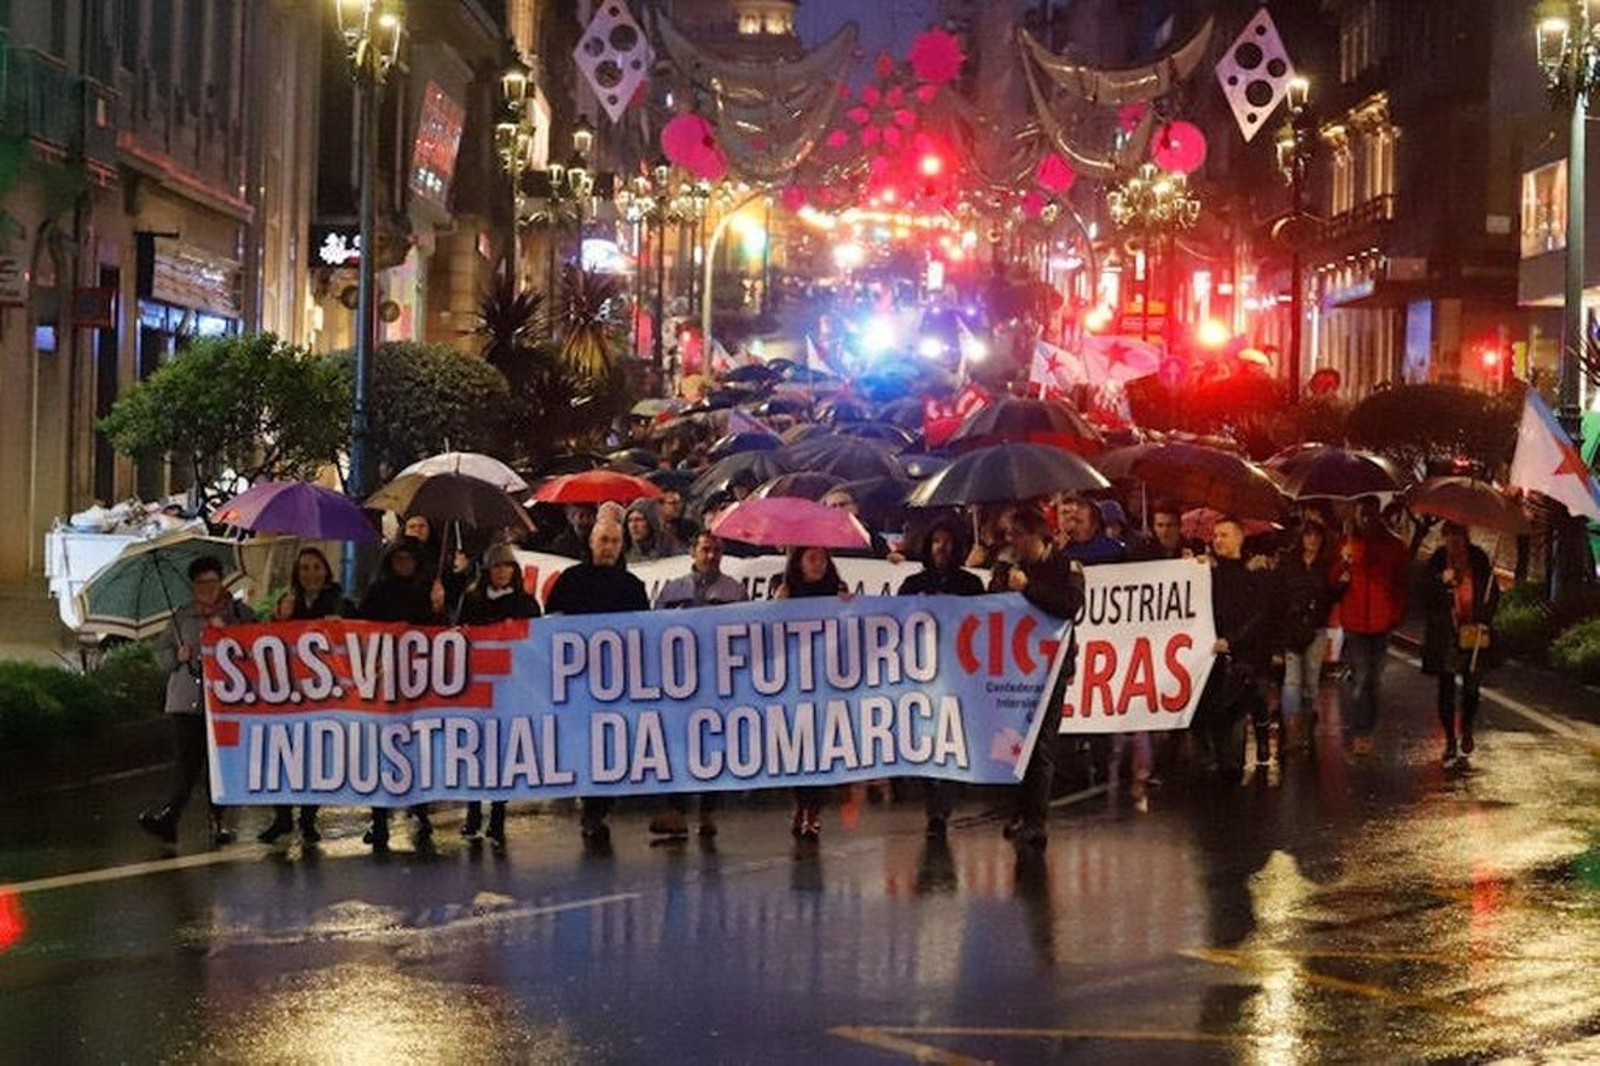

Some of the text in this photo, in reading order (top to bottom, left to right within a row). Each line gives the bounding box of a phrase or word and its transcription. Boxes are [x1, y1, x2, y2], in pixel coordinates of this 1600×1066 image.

[552, 611, 938, 703] POLO FUTURO
[1061, 633, 1193, 718] RAS
[249, 690, 969, 795] INDUSTRIAL DA COMARCA
